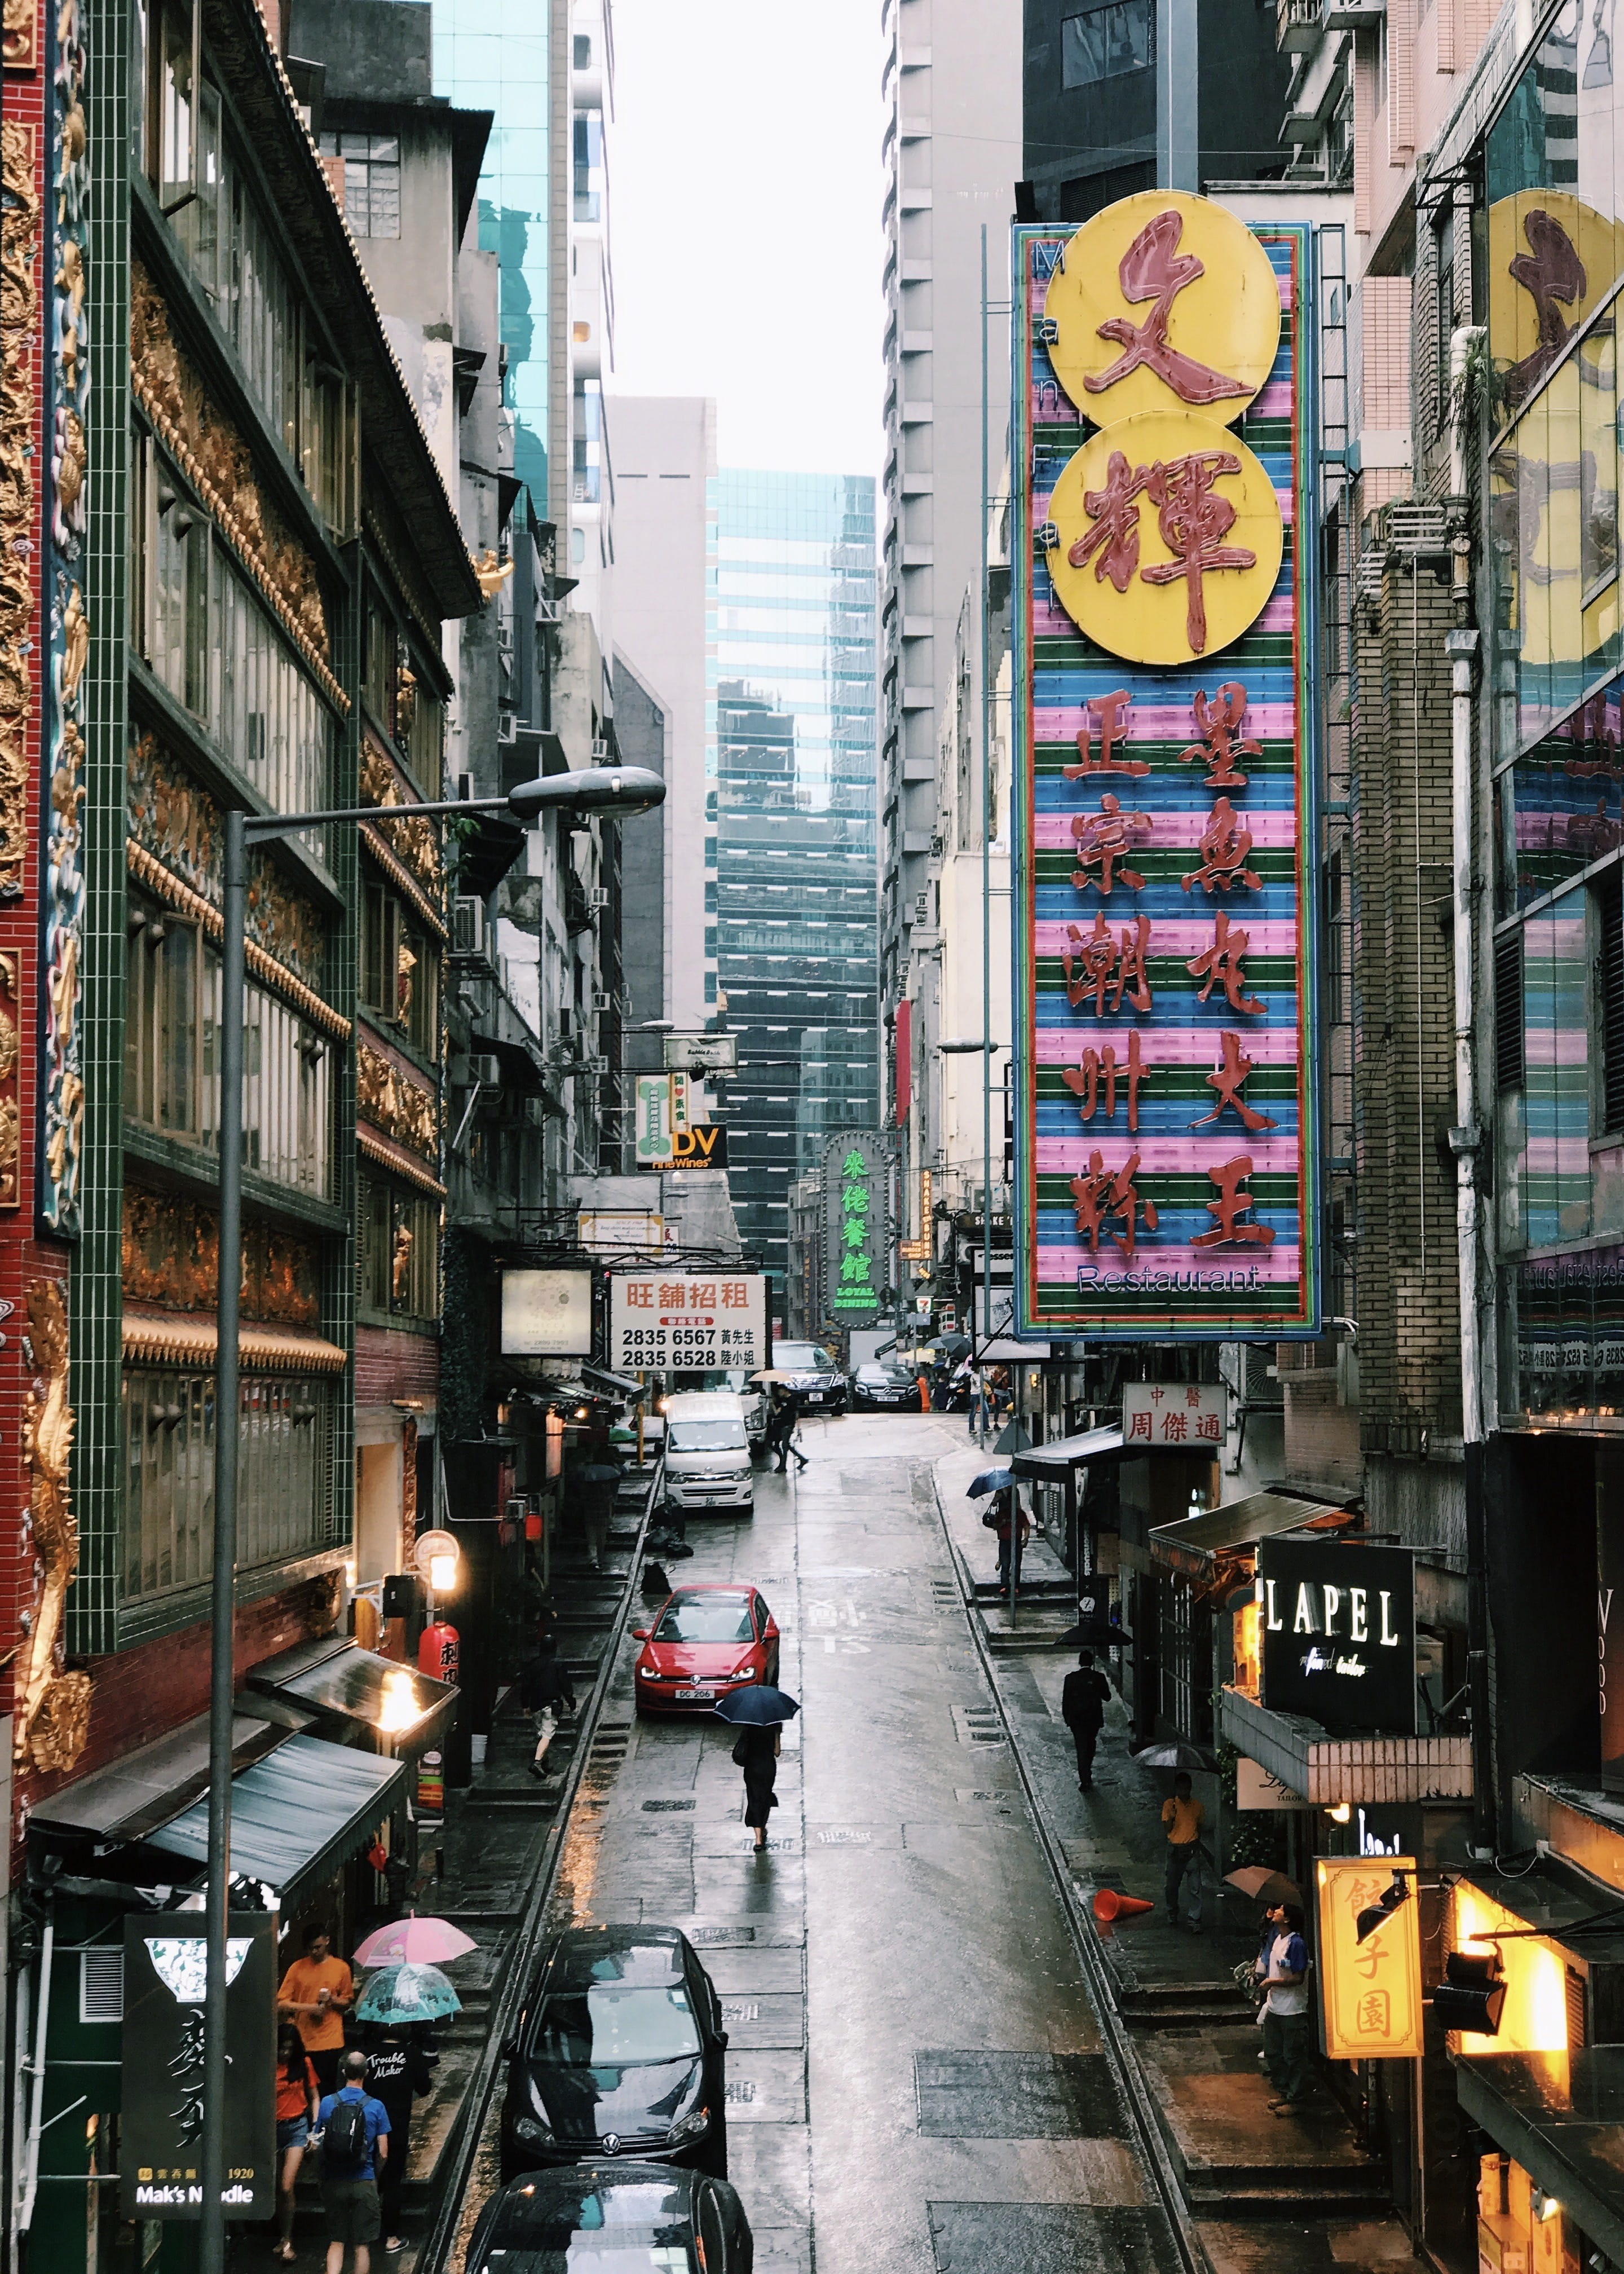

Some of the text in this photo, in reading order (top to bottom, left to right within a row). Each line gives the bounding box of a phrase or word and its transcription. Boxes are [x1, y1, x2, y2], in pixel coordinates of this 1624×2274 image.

[1068, 209, 1257, 653] 文輝
[1177, 680, 1280, 1248] 墨魚丸大王
[840, 1149, 872, 1283] 來佬餐館
[1076, 1263, 1263, 1293] Restaurant
[626, 1282, 749, 1309] 旺舖招租
[837, 1288, 875, 1296] LOYAL
[833, 1299, 878, 1308] DINING
[623, 1329, 666, 1345] 2835
[672, 1329, 716, 1345] 6567
[721, 1329, 754, 1345] 黃先生
[623, 1350, 754, 1366] 2835 6528 陸小姐
[1150, 1386, 1202, 1408] 中醫
[1128, 1411, 1224, 1442] 周傑通
[1265, 1579, 1398, 1647] LAPEL
[367, 2052, 407, 2068] Trouble
[228, 2168, 254, 2179] 1920
[136, 2185, 254, 2203] Mak's Ndle
